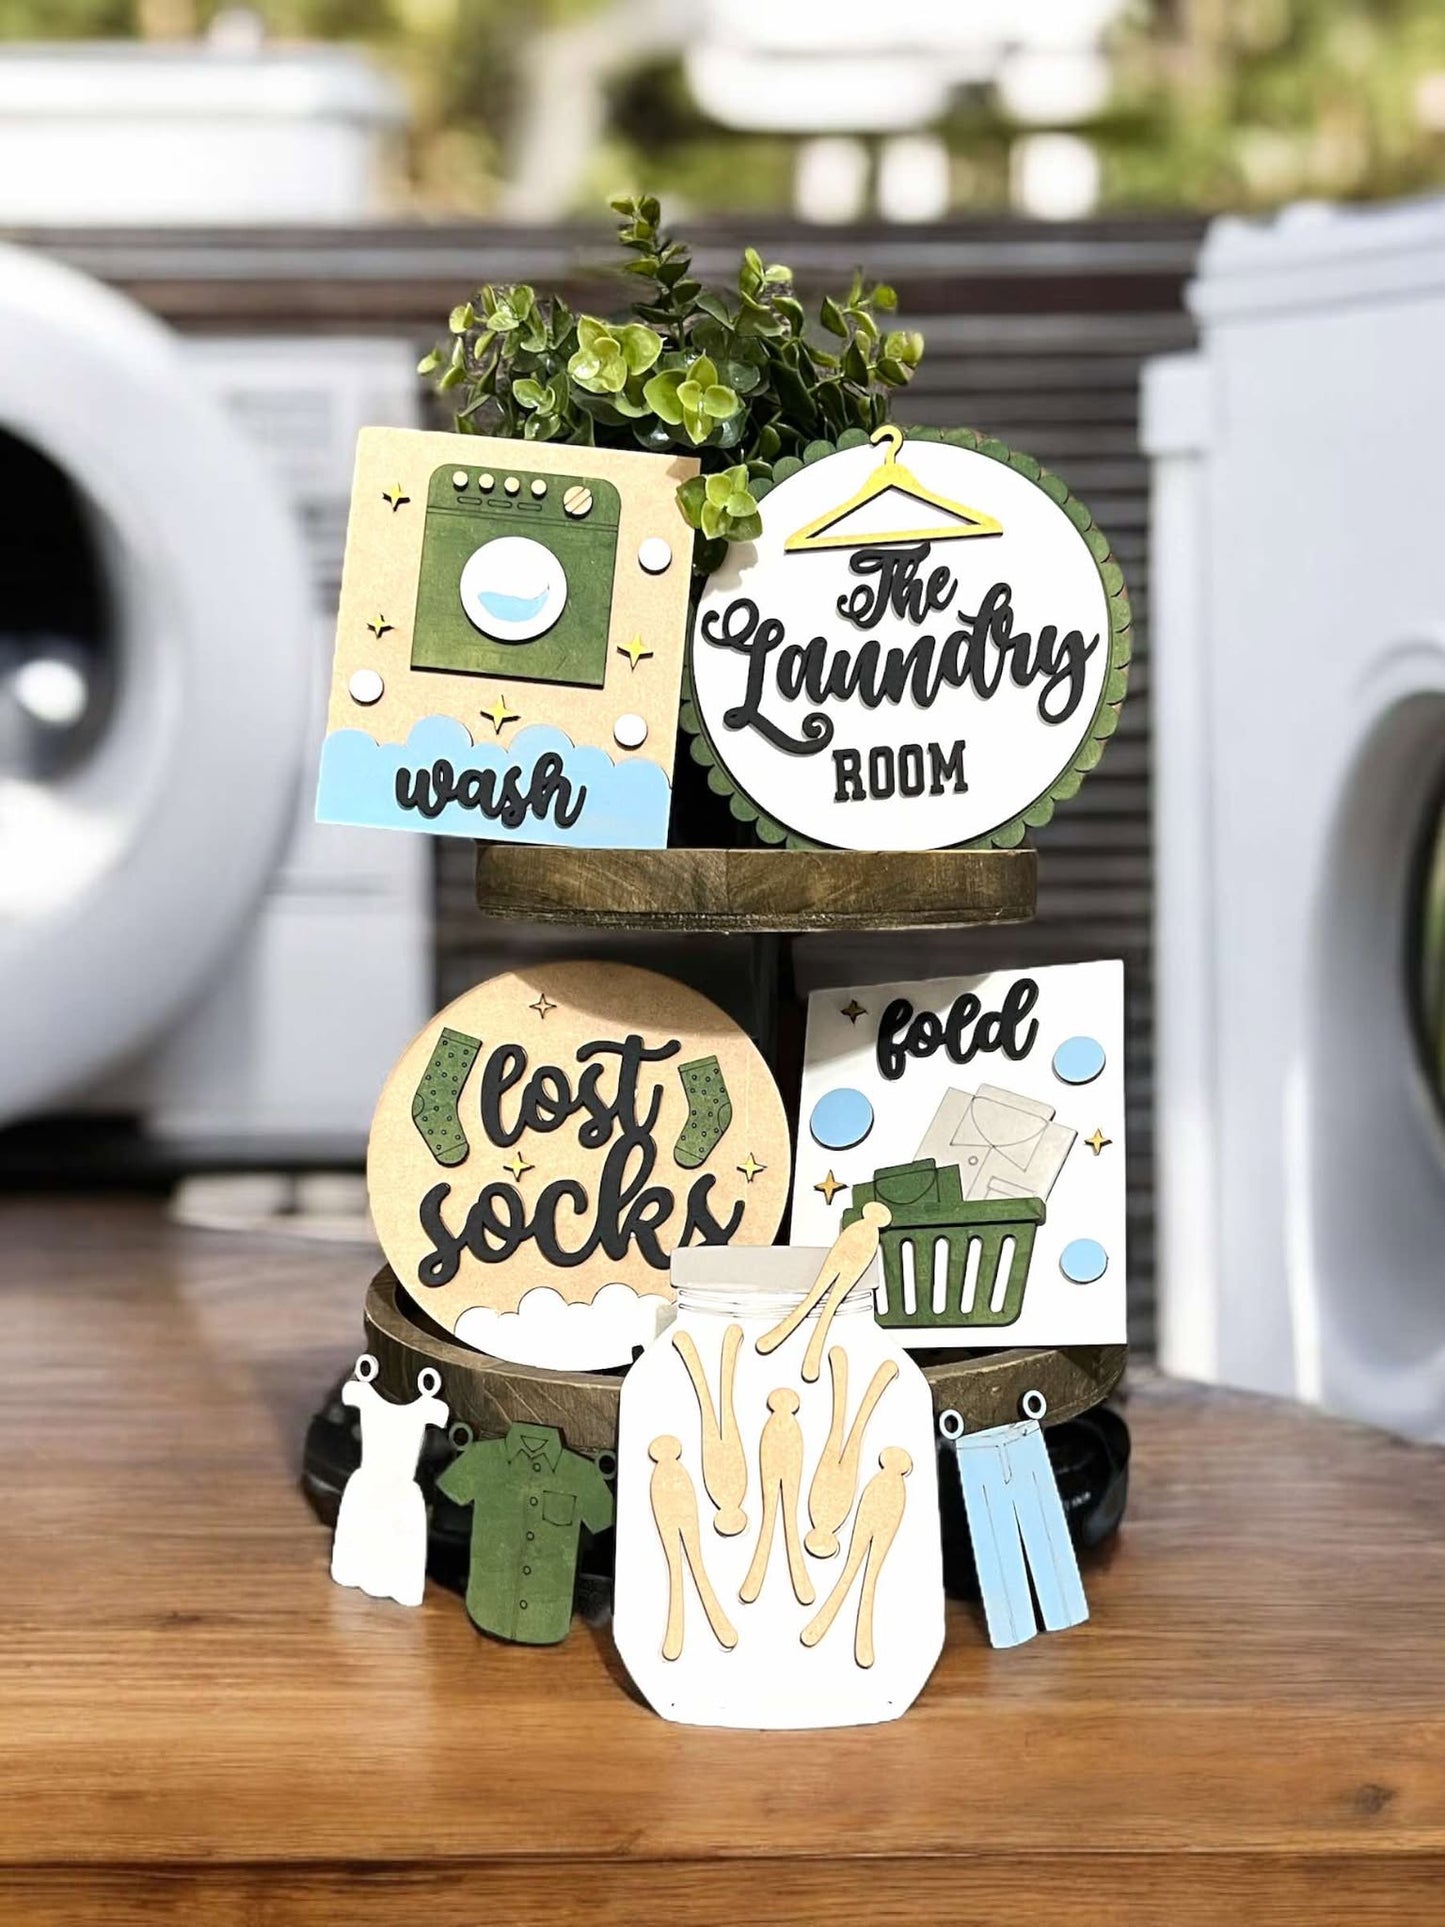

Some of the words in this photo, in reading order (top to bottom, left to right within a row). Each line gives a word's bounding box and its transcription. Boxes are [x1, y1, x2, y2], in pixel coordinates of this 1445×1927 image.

[837, 541, 958, 629] The
[701, 582, 1099, 755] Laundry
[395, 752, 587, 829] wash
[832, 740, 969, 803] ROOM
[876, 978, 1039, 1080] fold
[480, 1034, 682, 1149] lost
[418, 1134, 745, 1287] socks
